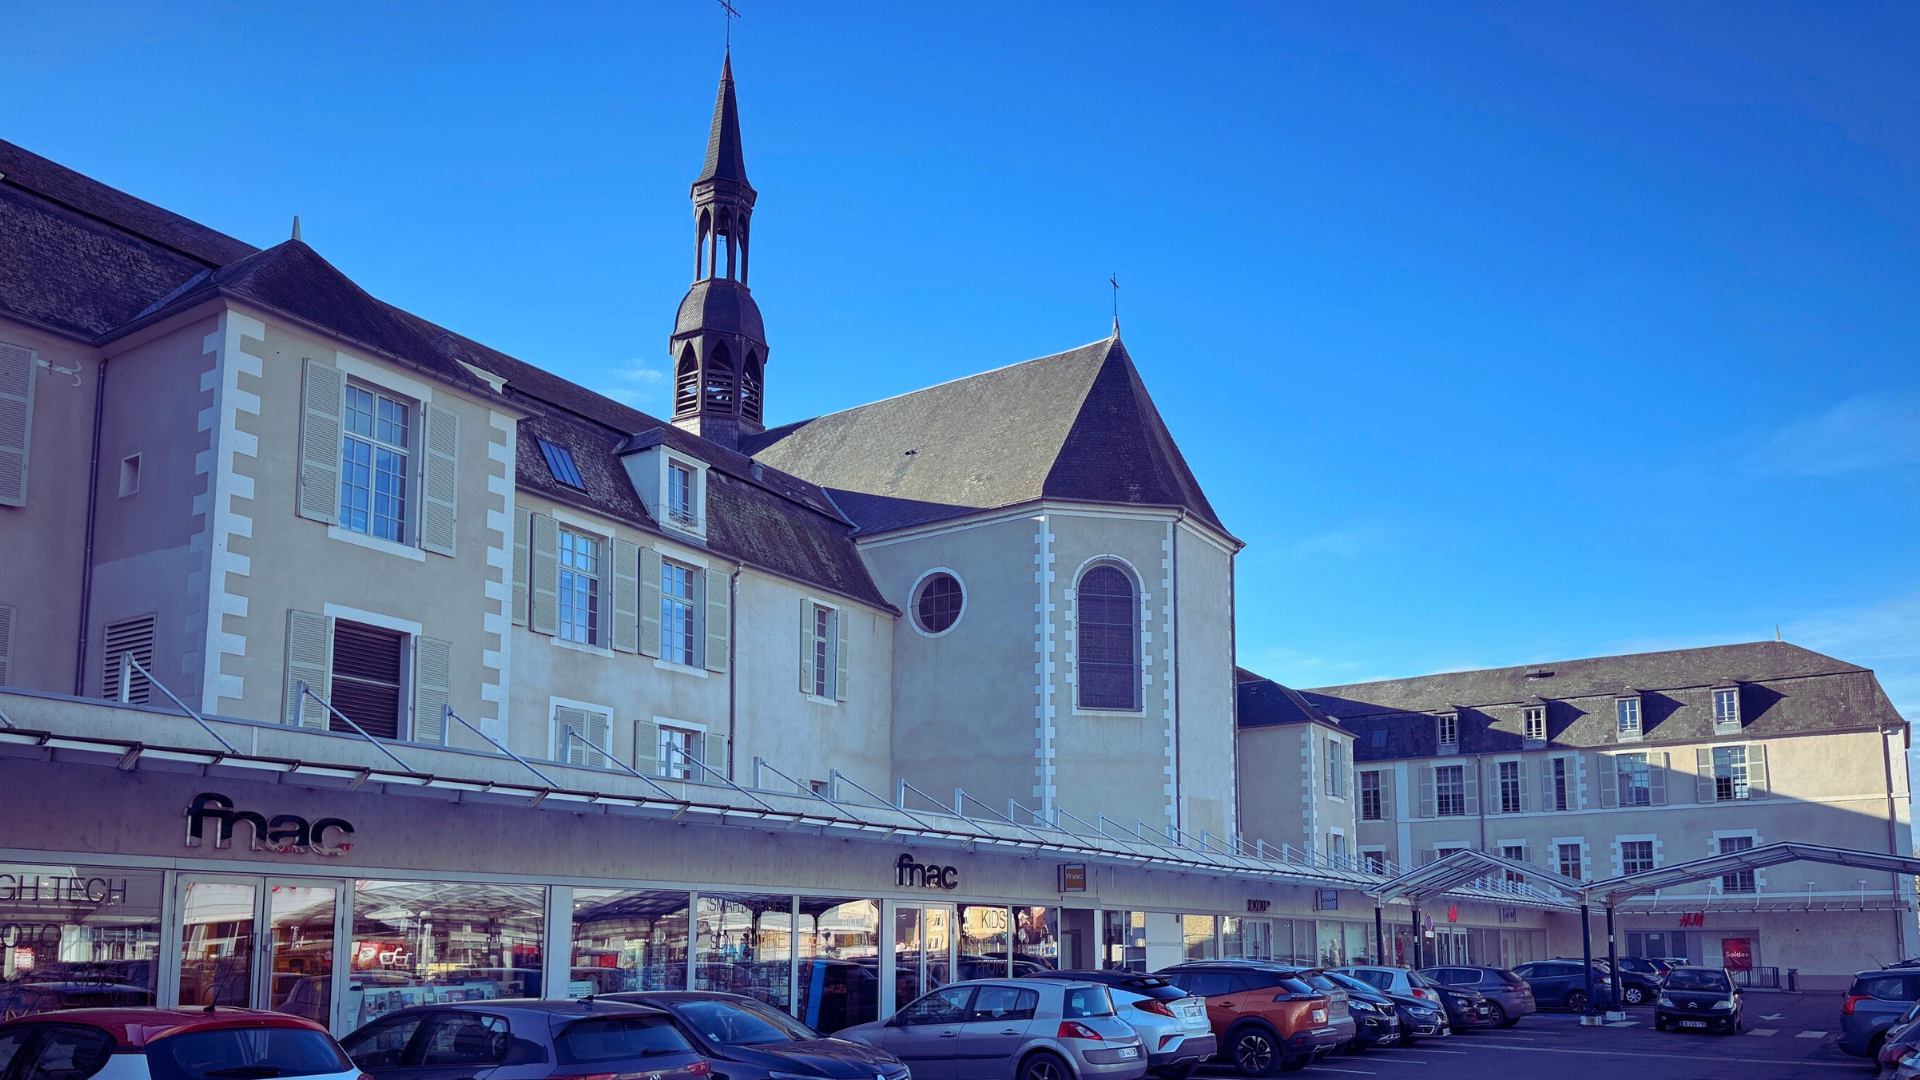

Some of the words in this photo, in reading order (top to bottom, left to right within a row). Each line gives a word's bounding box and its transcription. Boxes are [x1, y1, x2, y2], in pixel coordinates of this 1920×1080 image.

[184, 792, 355, 857] fnac
[895, 853, 958, 889] fnac
[1066, 872, 1083, 880] fnac
[48, 876, 127, 903] TECH
[981, 909, 1007, 930] KIDS
[710, 934, 734, 950] SON
[1725, 950, 1749, 958] Soldes
